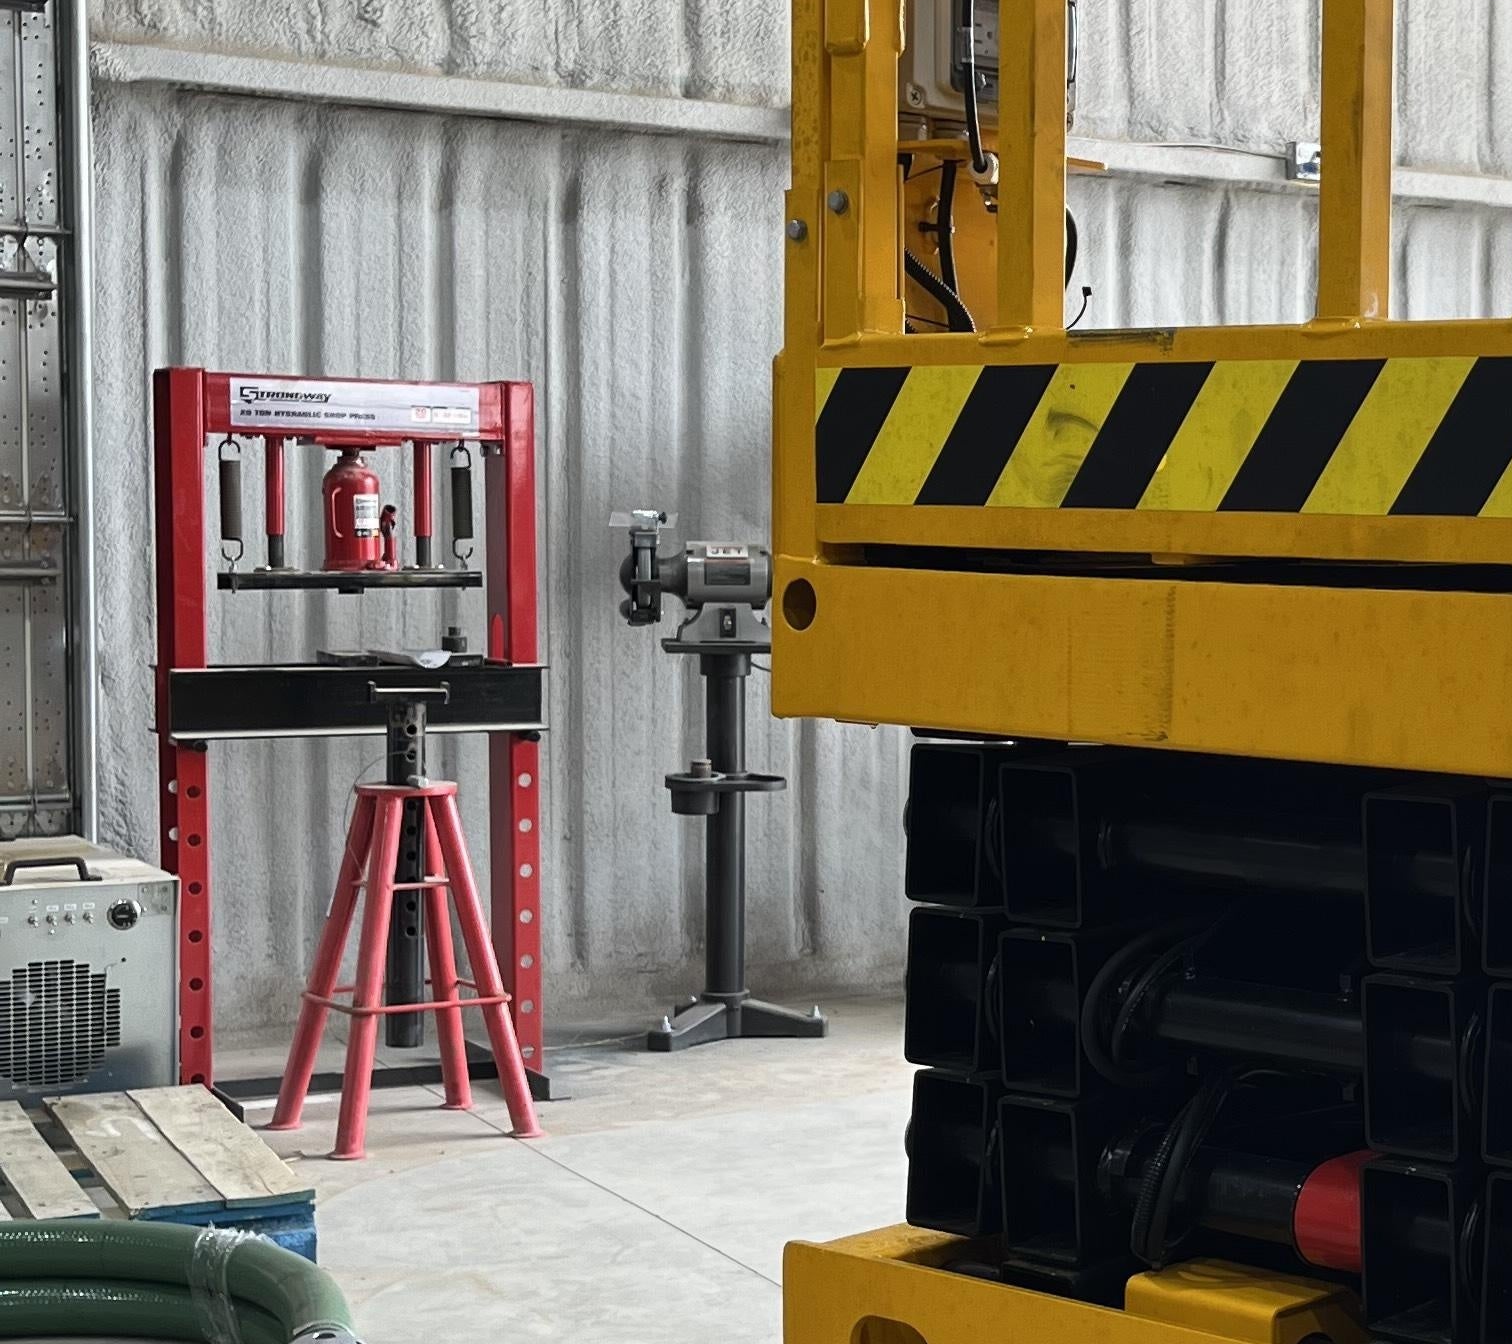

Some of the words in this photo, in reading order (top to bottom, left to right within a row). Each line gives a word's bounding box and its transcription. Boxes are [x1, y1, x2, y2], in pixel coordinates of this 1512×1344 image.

[254, 409, 272, 417] TON
[274, 410, 322, 419] HYDRAULIC
[323, 411, 347, 419] SHOP
[710, 546, 743, 555] JET
